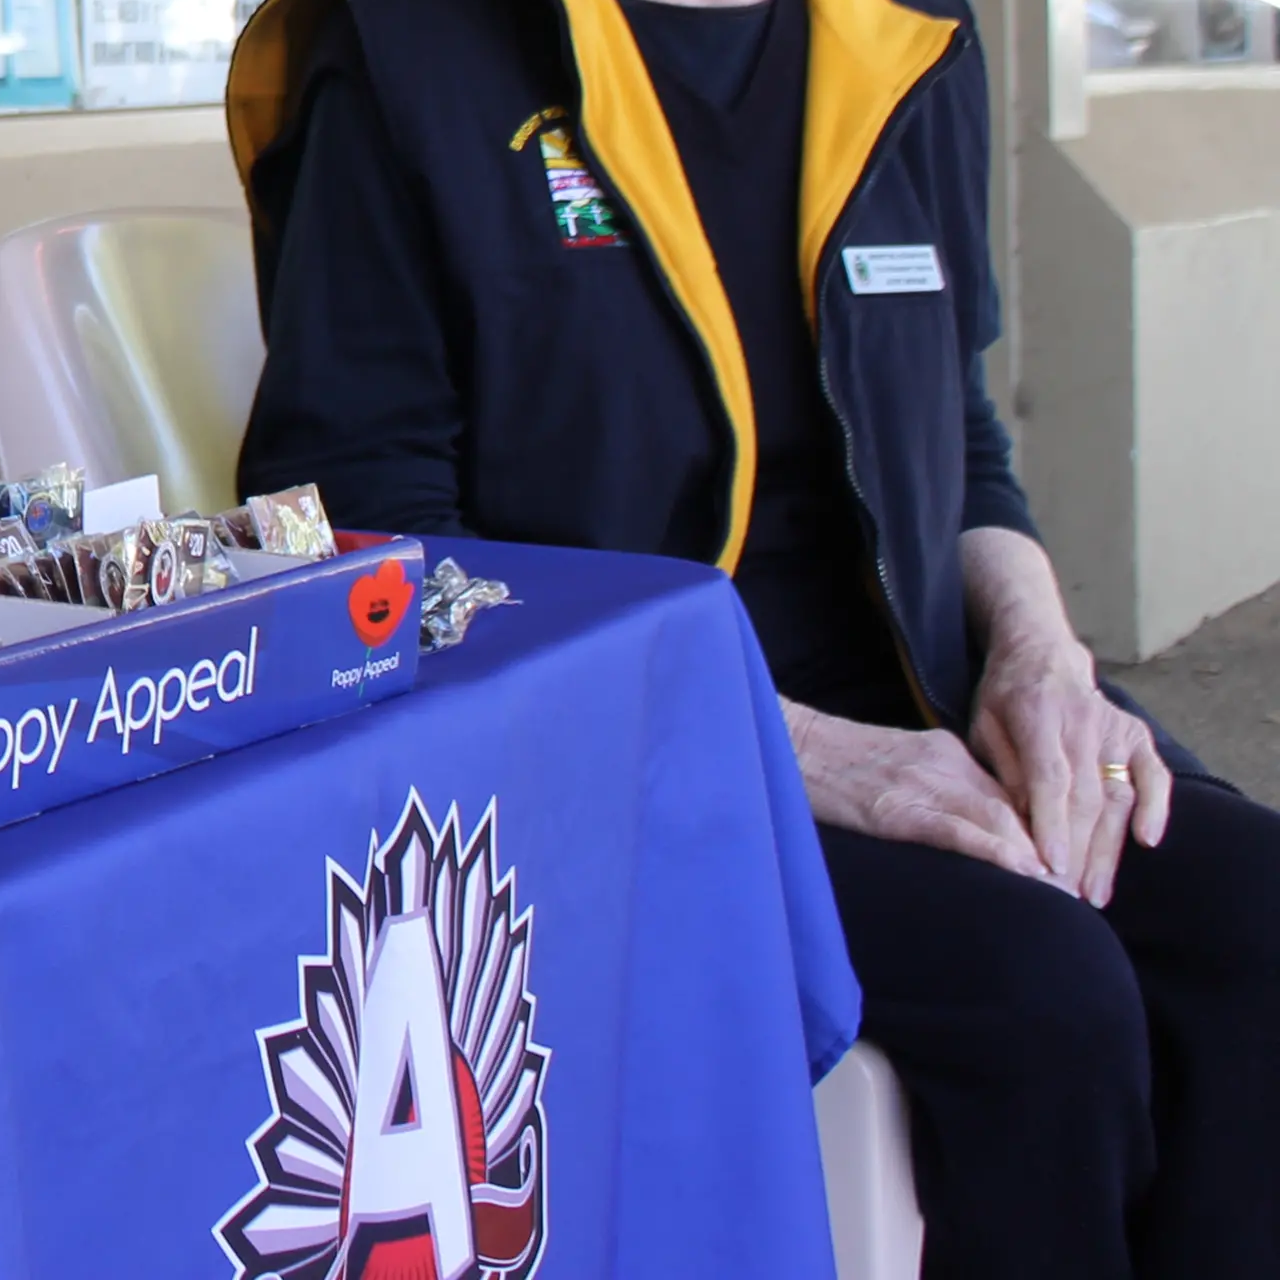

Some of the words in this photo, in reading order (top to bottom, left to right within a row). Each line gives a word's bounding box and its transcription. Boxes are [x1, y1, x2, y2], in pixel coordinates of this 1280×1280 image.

[86, 625, 259, 755] Appeal
[331, 666, 364, 689] Poppy
[363, 651, 400, 680] Appeal
